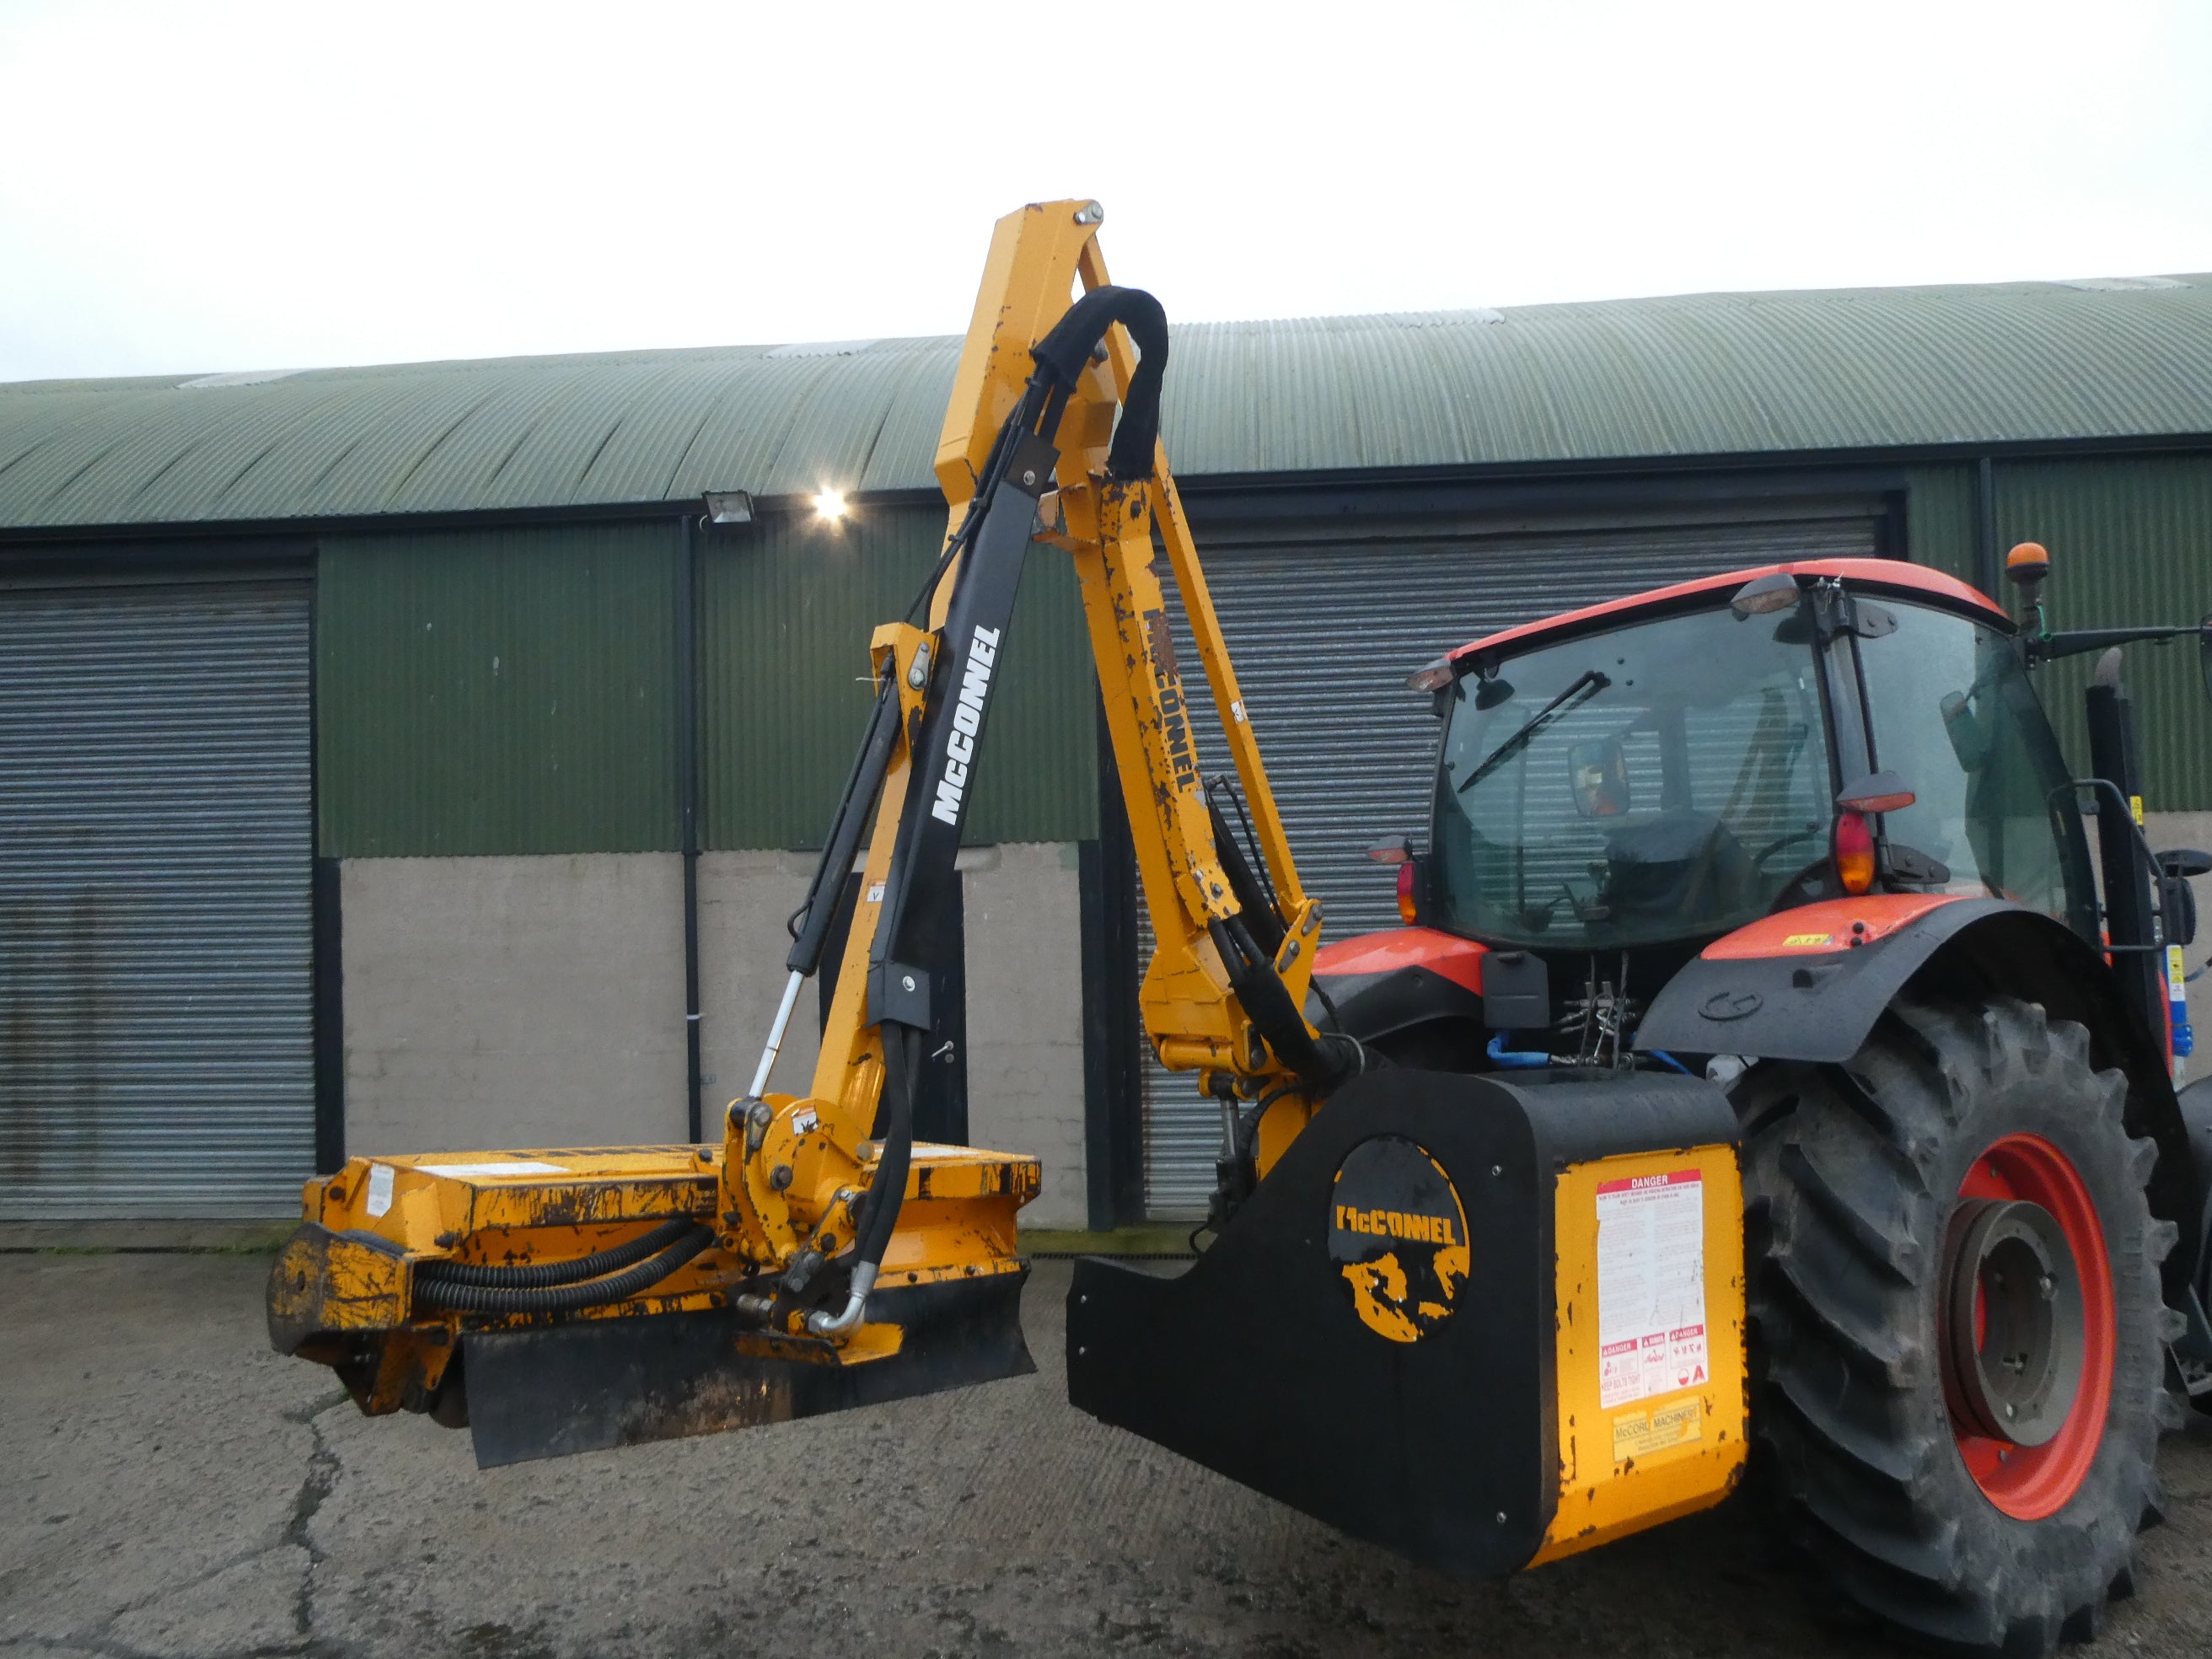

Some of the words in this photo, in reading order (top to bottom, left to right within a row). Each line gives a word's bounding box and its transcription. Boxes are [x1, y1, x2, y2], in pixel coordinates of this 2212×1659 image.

[1143, 609, 1195, 794] CONNEL
[932, 625, 1001, 826] McCONNEL
[1631, 1174, 1668, 1189] DANGER
[1336, 1205, 1457, 1246] McCONNEL
[1675, 1327, 1698, 1340] DANGER
[1608, 1342, 1631, 1355] DANGER
